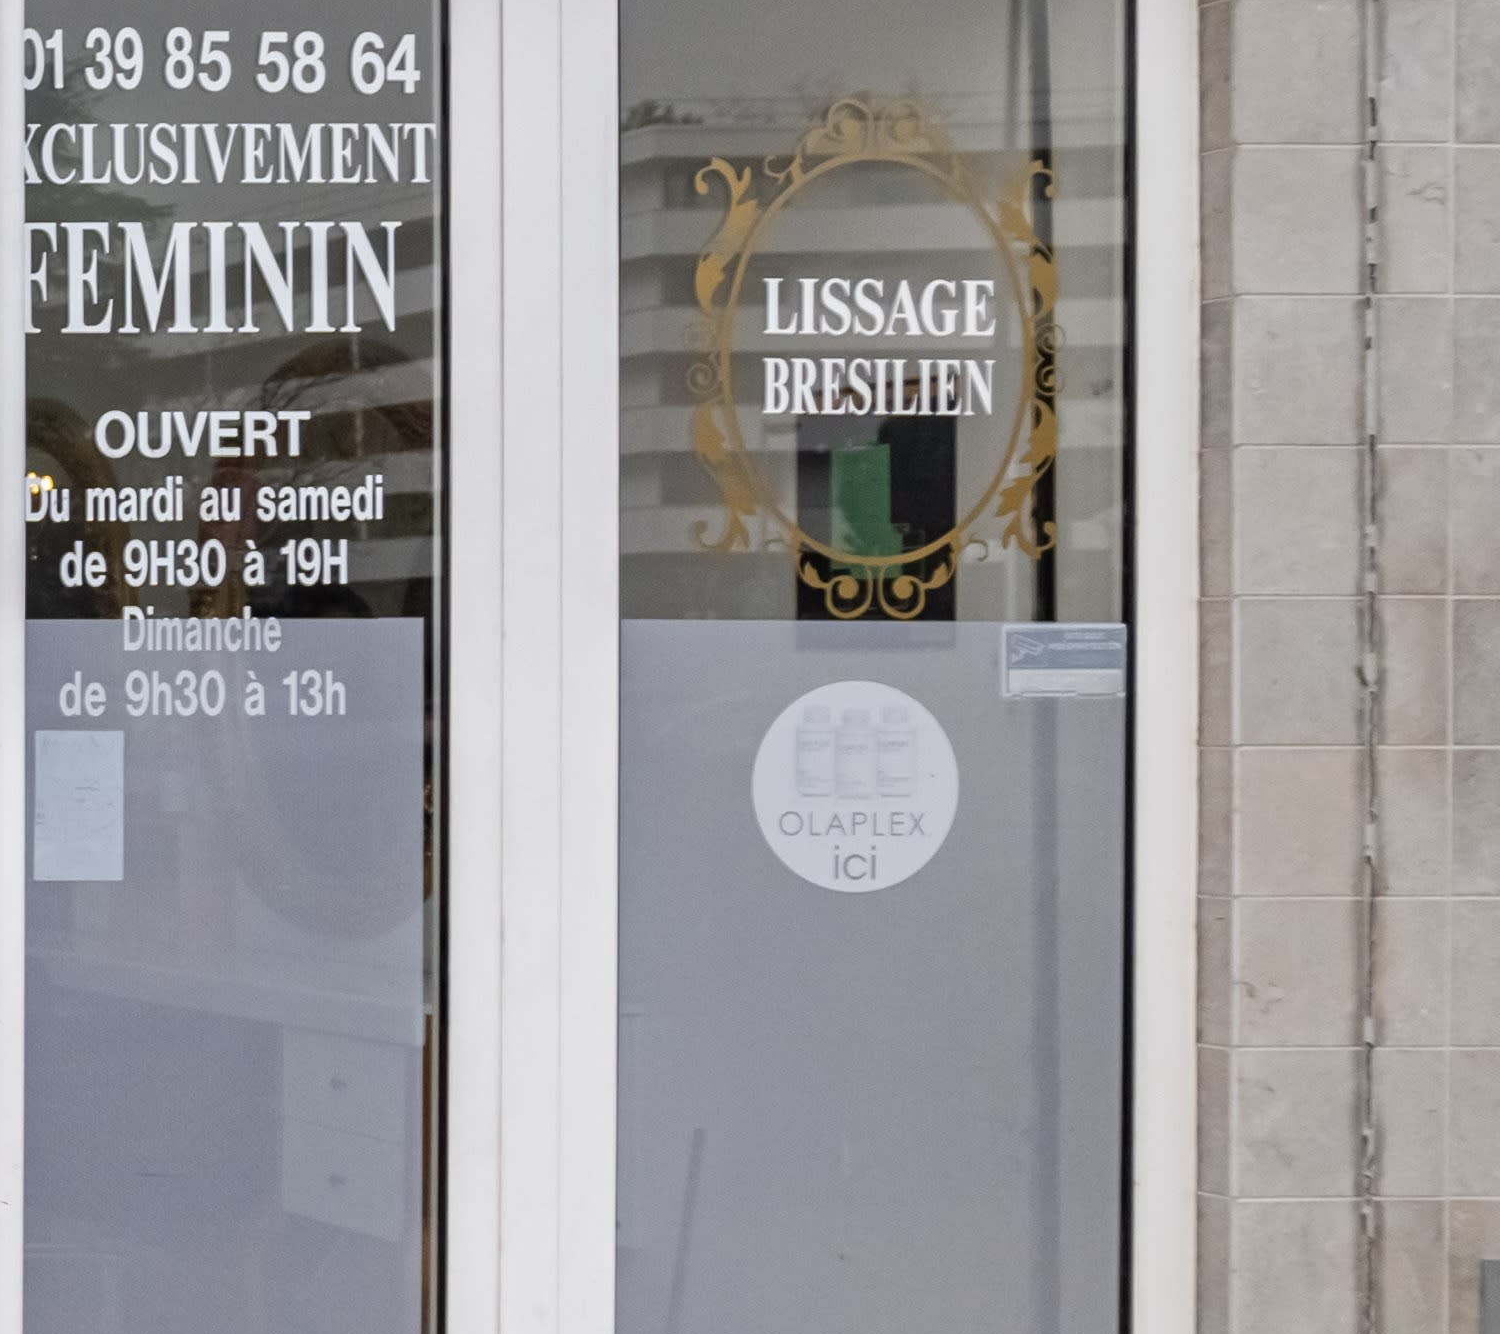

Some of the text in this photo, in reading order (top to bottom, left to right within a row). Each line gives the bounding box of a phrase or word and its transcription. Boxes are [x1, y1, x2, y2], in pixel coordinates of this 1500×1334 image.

[85, 27, 144, 90] 39
[166, 26, 231, 92] 85
[256, 31, 326, 94] 58
[351, 32, 421, 94] 64
[24, 221, 402, 334] FEMININ
[763, 277, 997, 337] LISSAGE
[762, 357, 996, 416] BRESILIEN
[95, 410, 311, 459] OUVERT
[25, 474, 384, 522] Du mardi au samedi
[60, 538, 349, 587] de 9H30 à 19H
[122, 606, 282, 653] Dimanche
[60, 670, 346, 717] de 9h30 à 13h
[779, 810, 926, 837] OLAPLEX
[833, 844, 876, 881] ici
